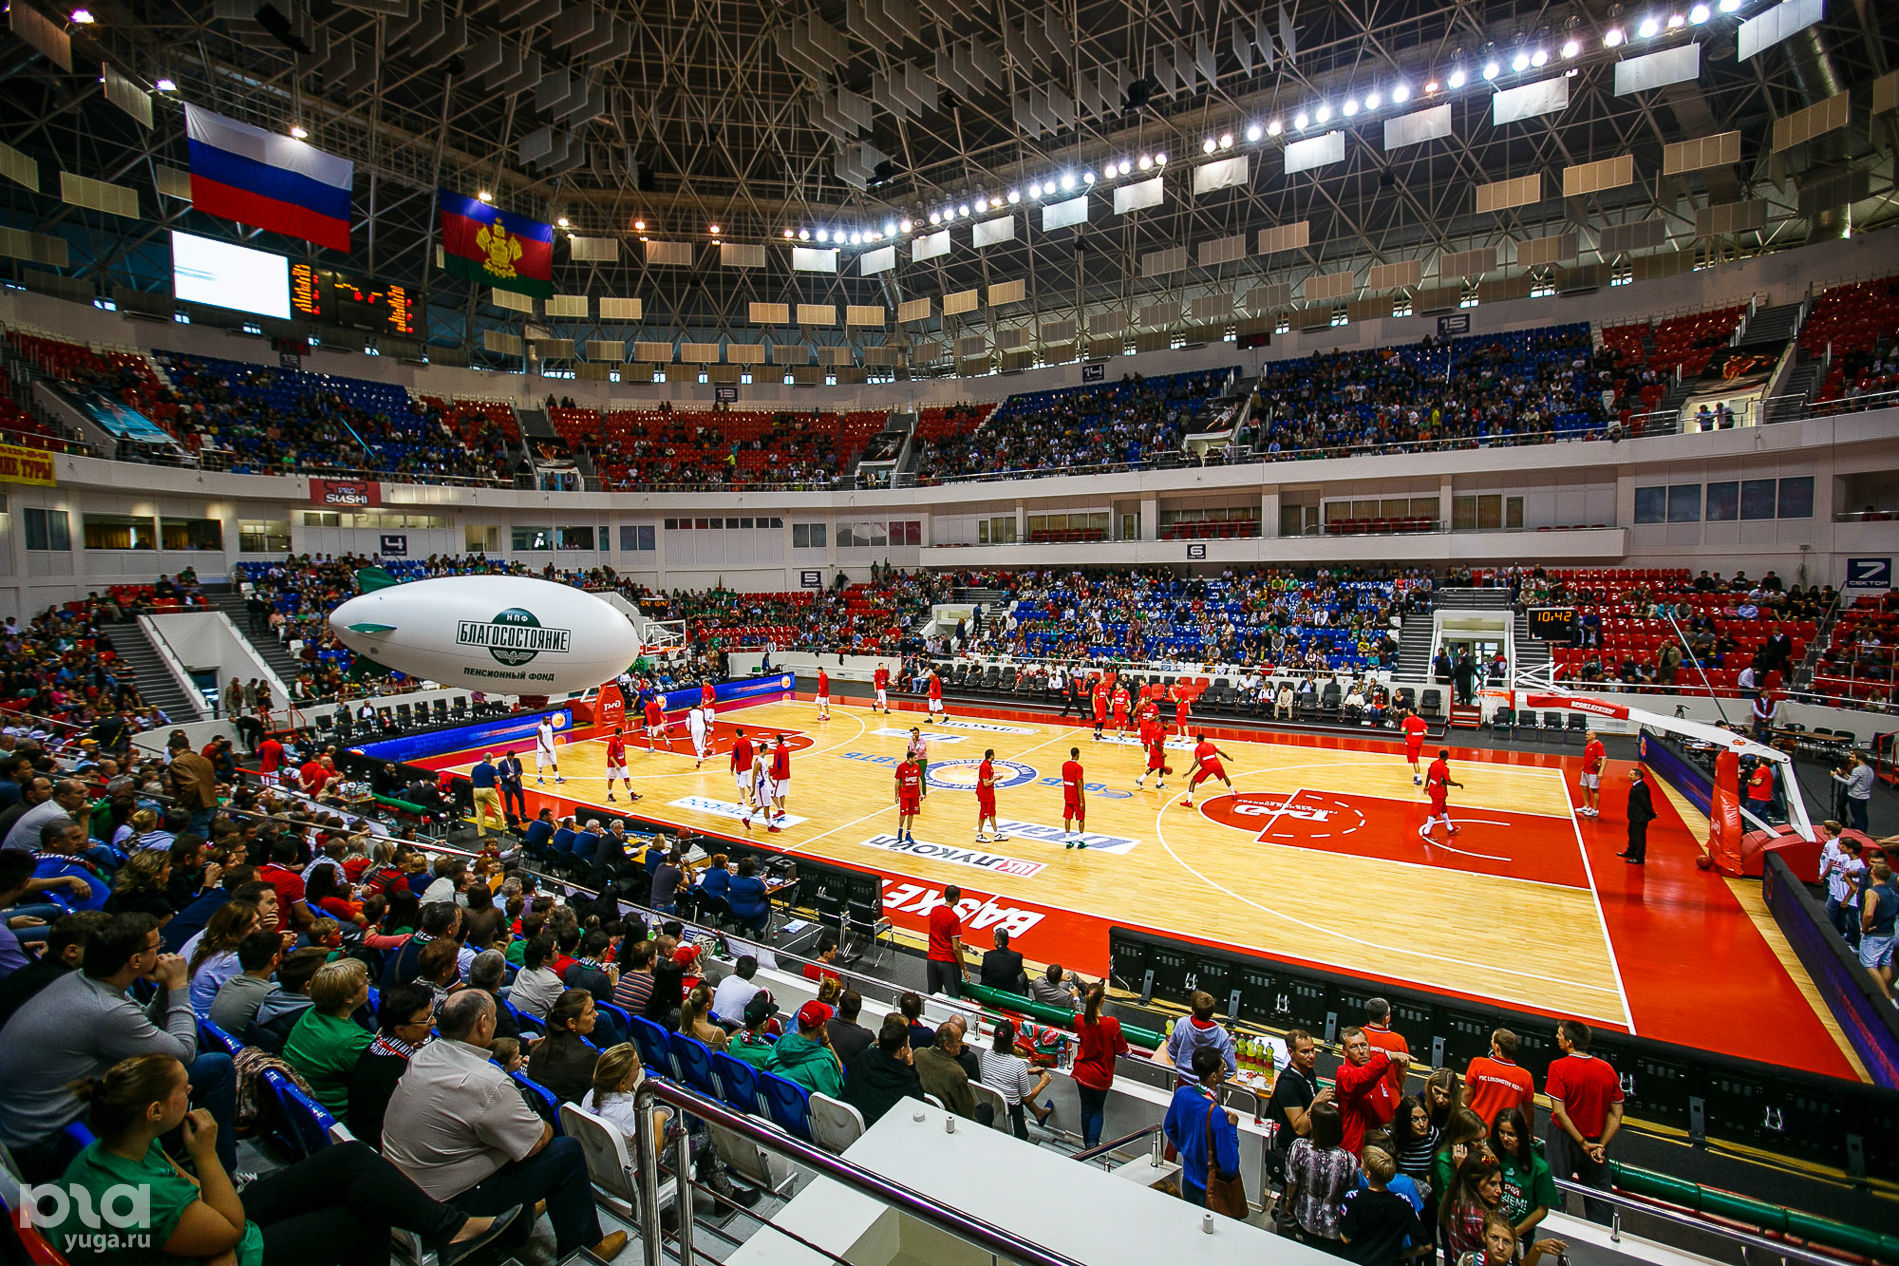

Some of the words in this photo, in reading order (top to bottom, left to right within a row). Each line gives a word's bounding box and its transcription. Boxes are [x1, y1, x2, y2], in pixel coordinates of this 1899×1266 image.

[1440, 315, 1467, 330] 15
[1084, 365, 1103, 377] 14
[717, 388, 735, 398] 13
[336, 486, 356, 495] PRO
[325, 493, 368, 505] SUSHI
[384, 537, 404, 550] 4
[1190, 545, 1204, 556] 6
[1857, 561, 1886, 579] 7
[804, 572, 818, 583] 5
[506, 613, 529, 622] НПФ
[460, 622, 568, 650] БЛАГОСОСТОЯНИЕ
[463, 666, 527, 680] ПЕНСИОННЫЙ
[528, 672, 555, 682] ФОНД
[1036, 777, 1107, 792] ВБ
[868, 835, 1005, 867] ЛУКОЙЛ
[882, 878, 1047, 939] BASKE
